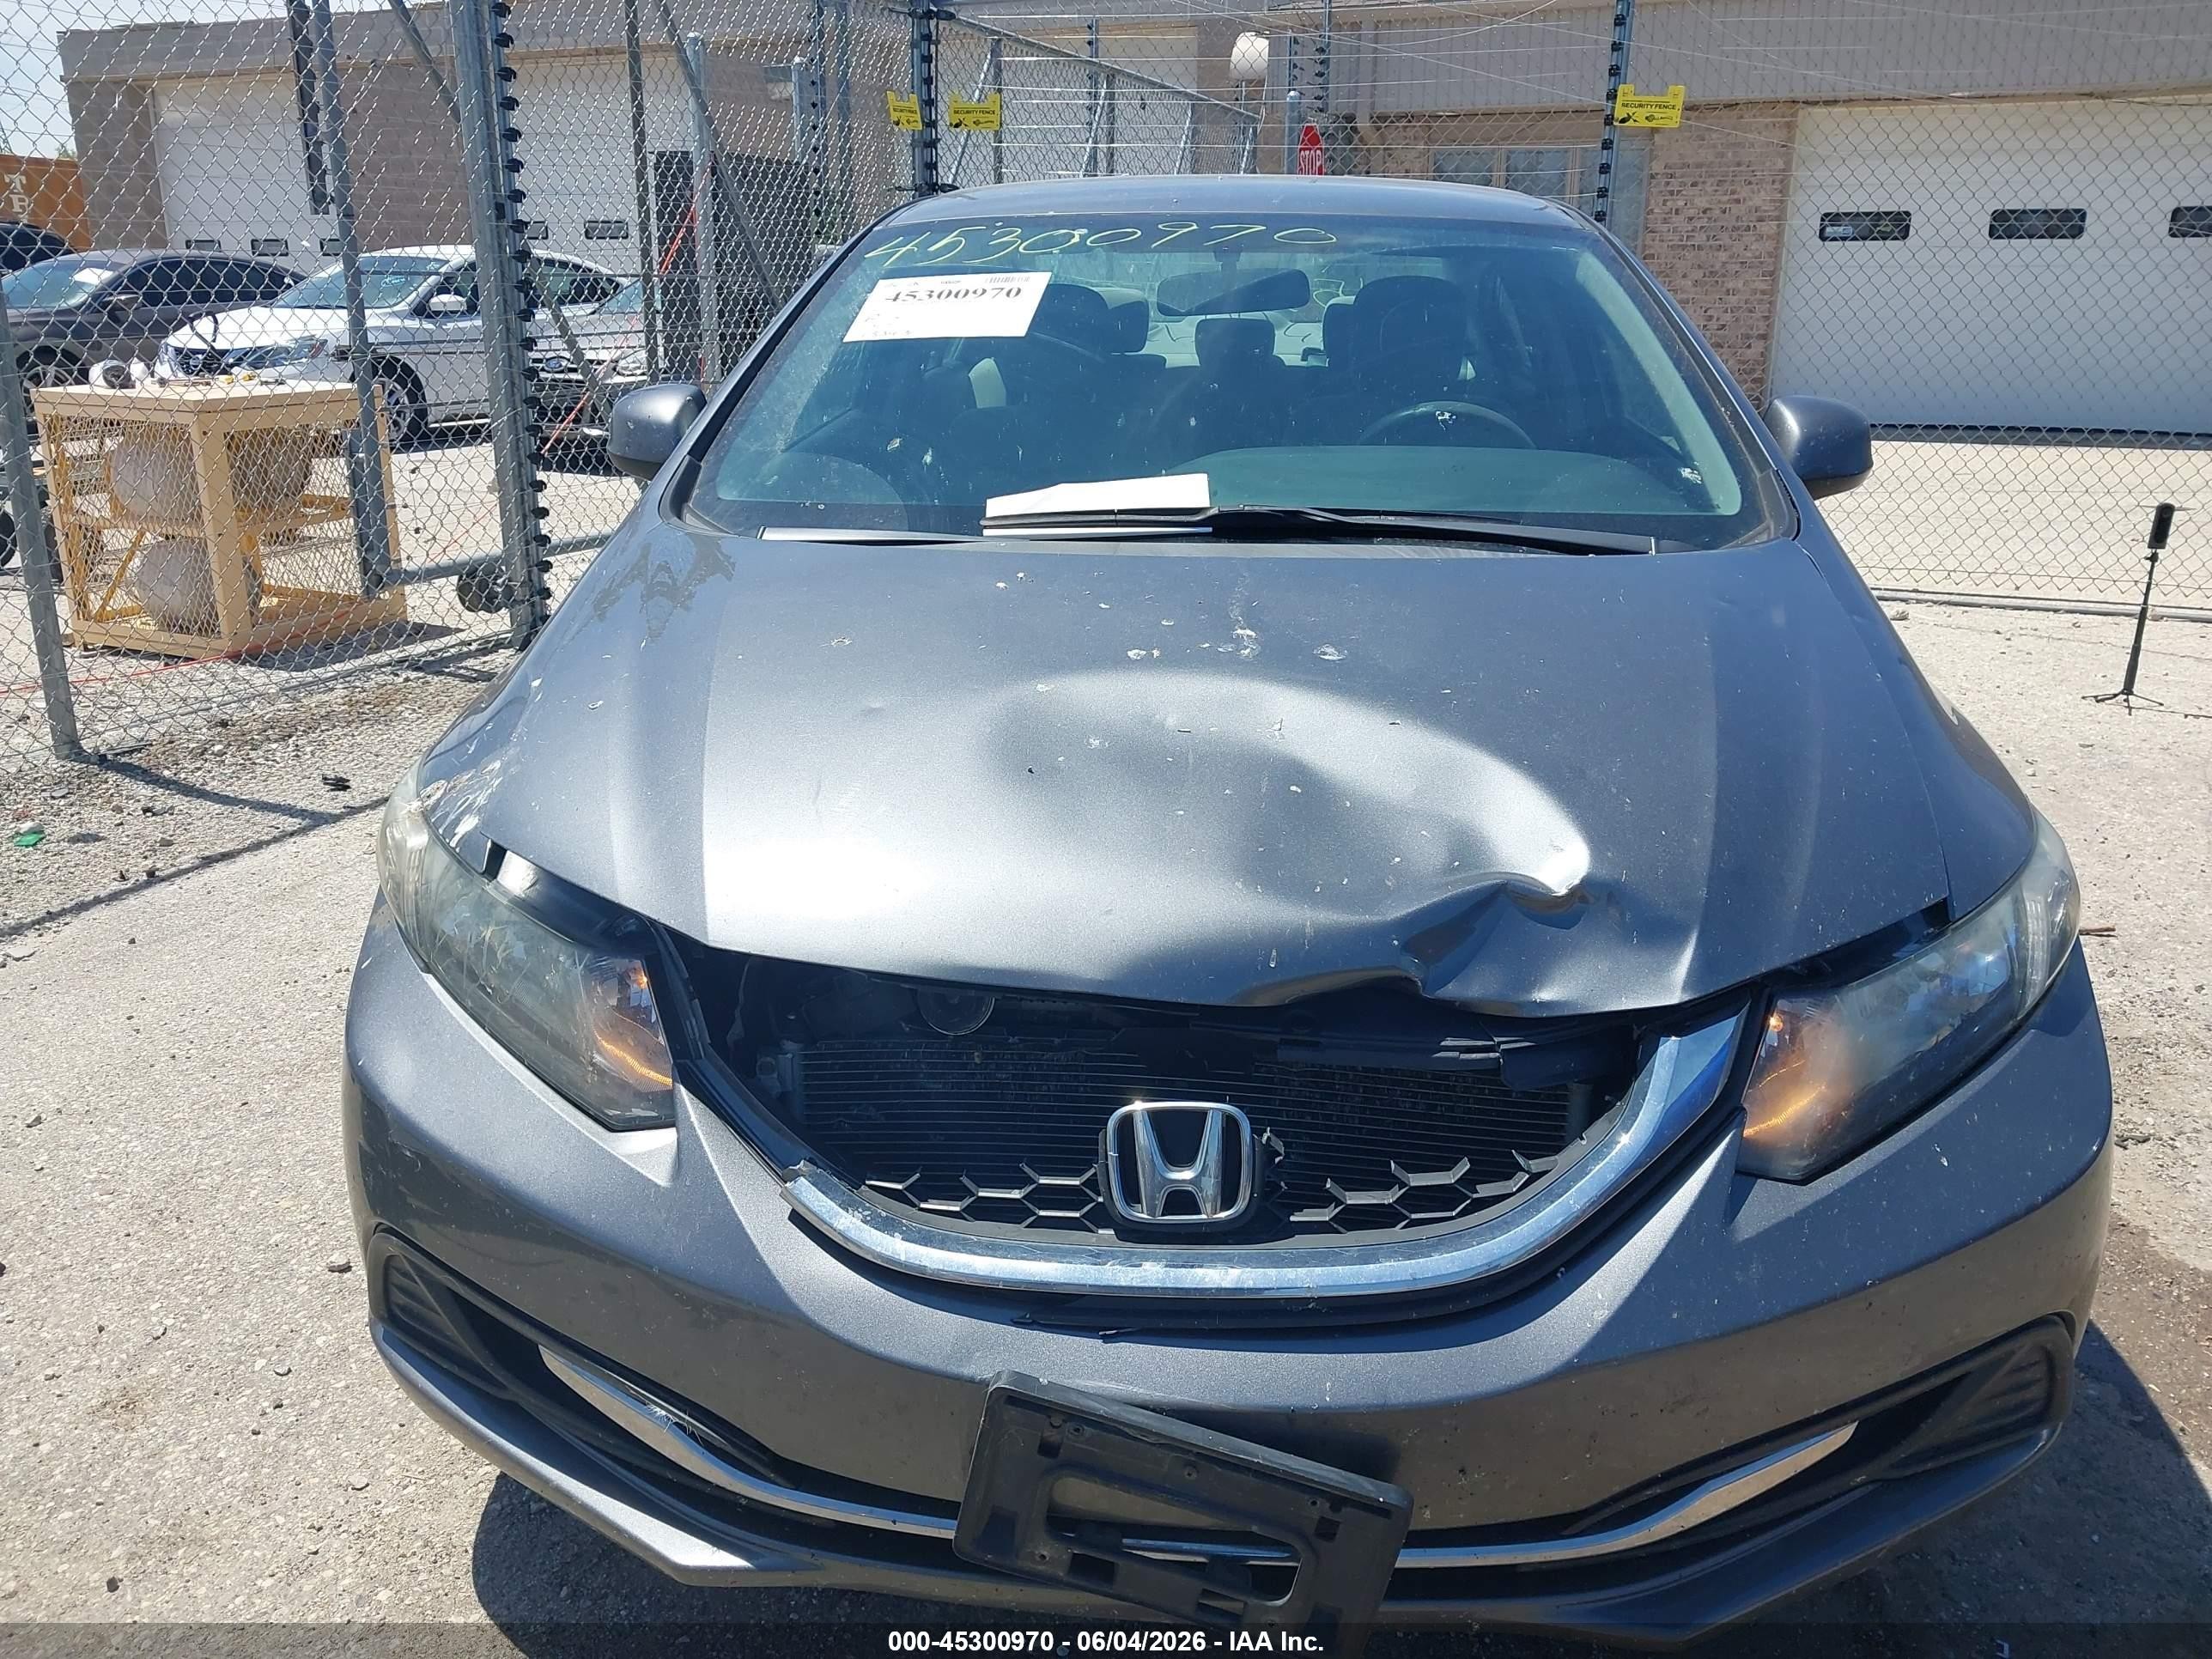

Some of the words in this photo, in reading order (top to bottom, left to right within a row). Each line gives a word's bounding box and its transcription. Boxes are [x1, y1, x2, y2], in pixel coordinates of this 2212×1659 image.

[1299, 149, 1322, 175] STOP
[863, 221, 1338, 268] 45300970
[885, 287, 1023, 302] 45300970
